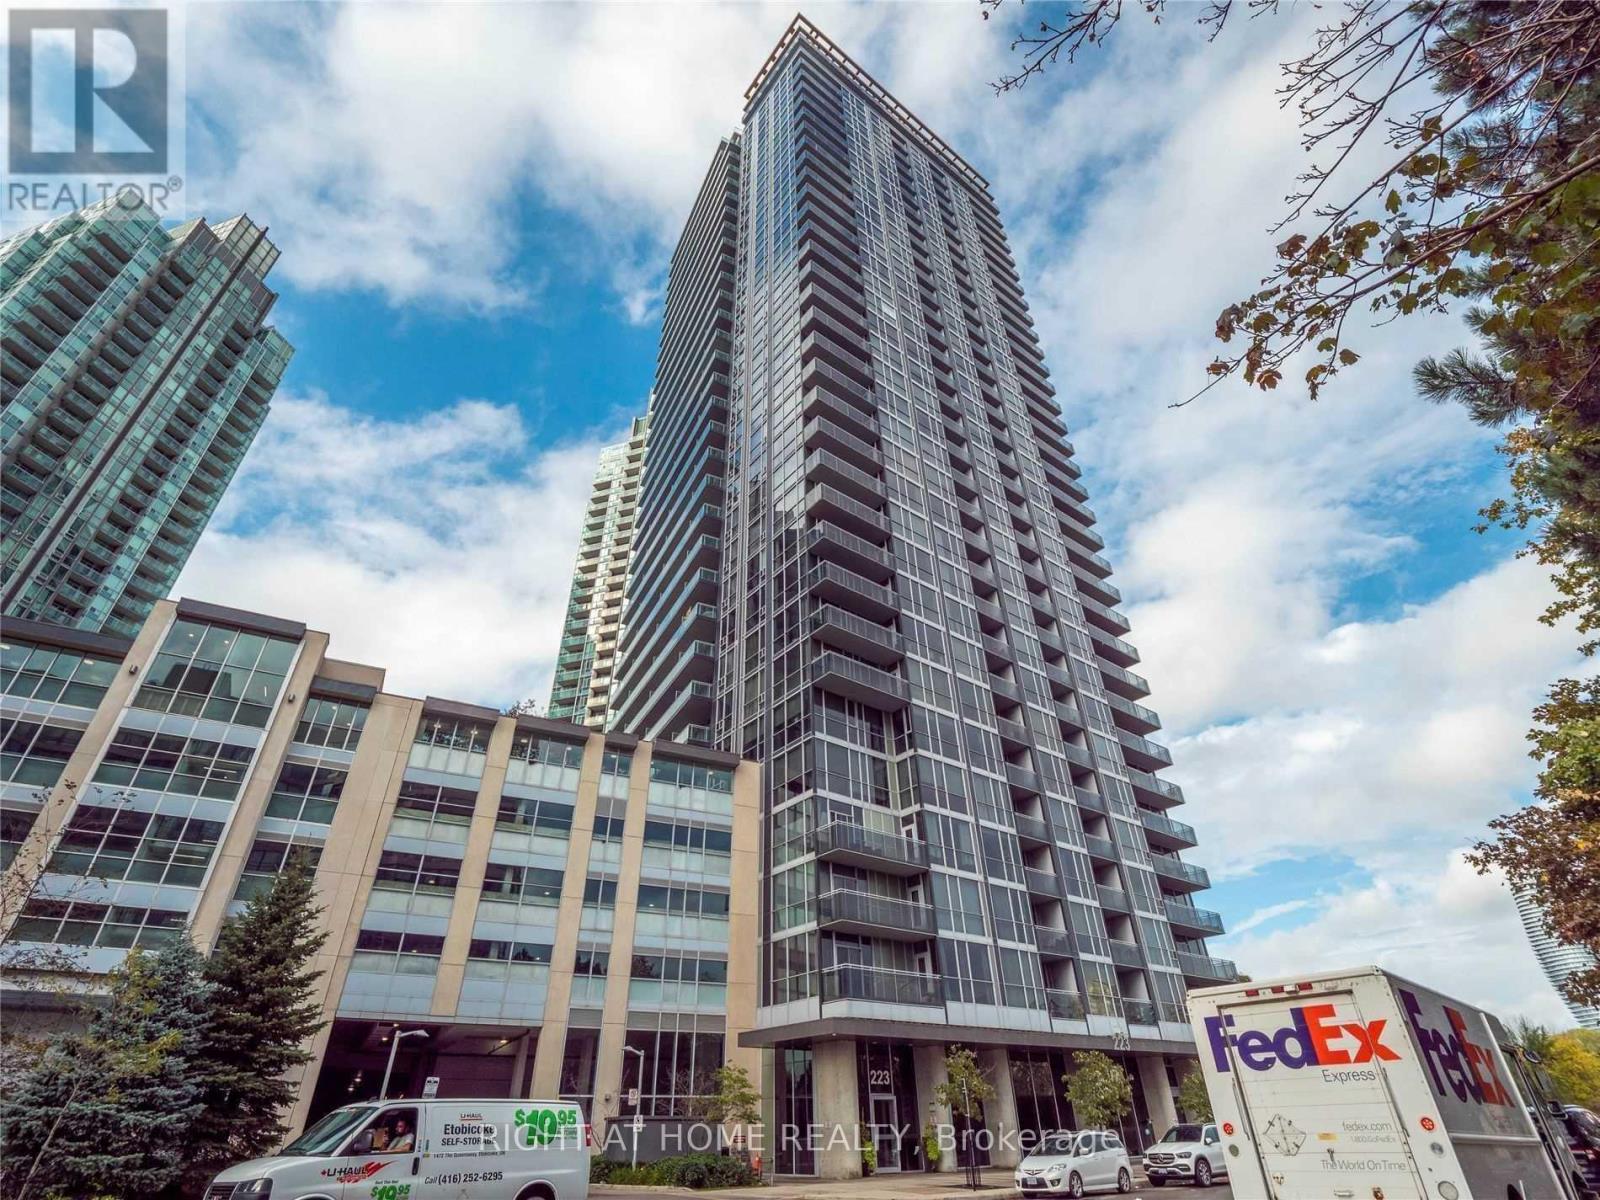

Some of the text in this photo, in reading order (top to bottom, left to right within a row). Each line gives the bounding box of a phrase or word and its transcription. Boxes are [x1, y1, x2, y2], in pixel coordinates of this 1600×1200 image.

[1204, 1004, 1402, 1073] FedEx
[1398, 988, 1516, 1108] FedEx
[870, 1070, 890, 1085] 223
[1322, 1069, 1376, 1084] Express
[444, 1124, 495, 1135] Etobicoke
[1342, 1121, 1393, 1132] fedex.com
[441, 1137, 497, 1146] SELF-STORAG
[1321, 1159, 1406, 1171] The World On Time
[424, 1171, 504, 1186] Call (416) 252-6295
